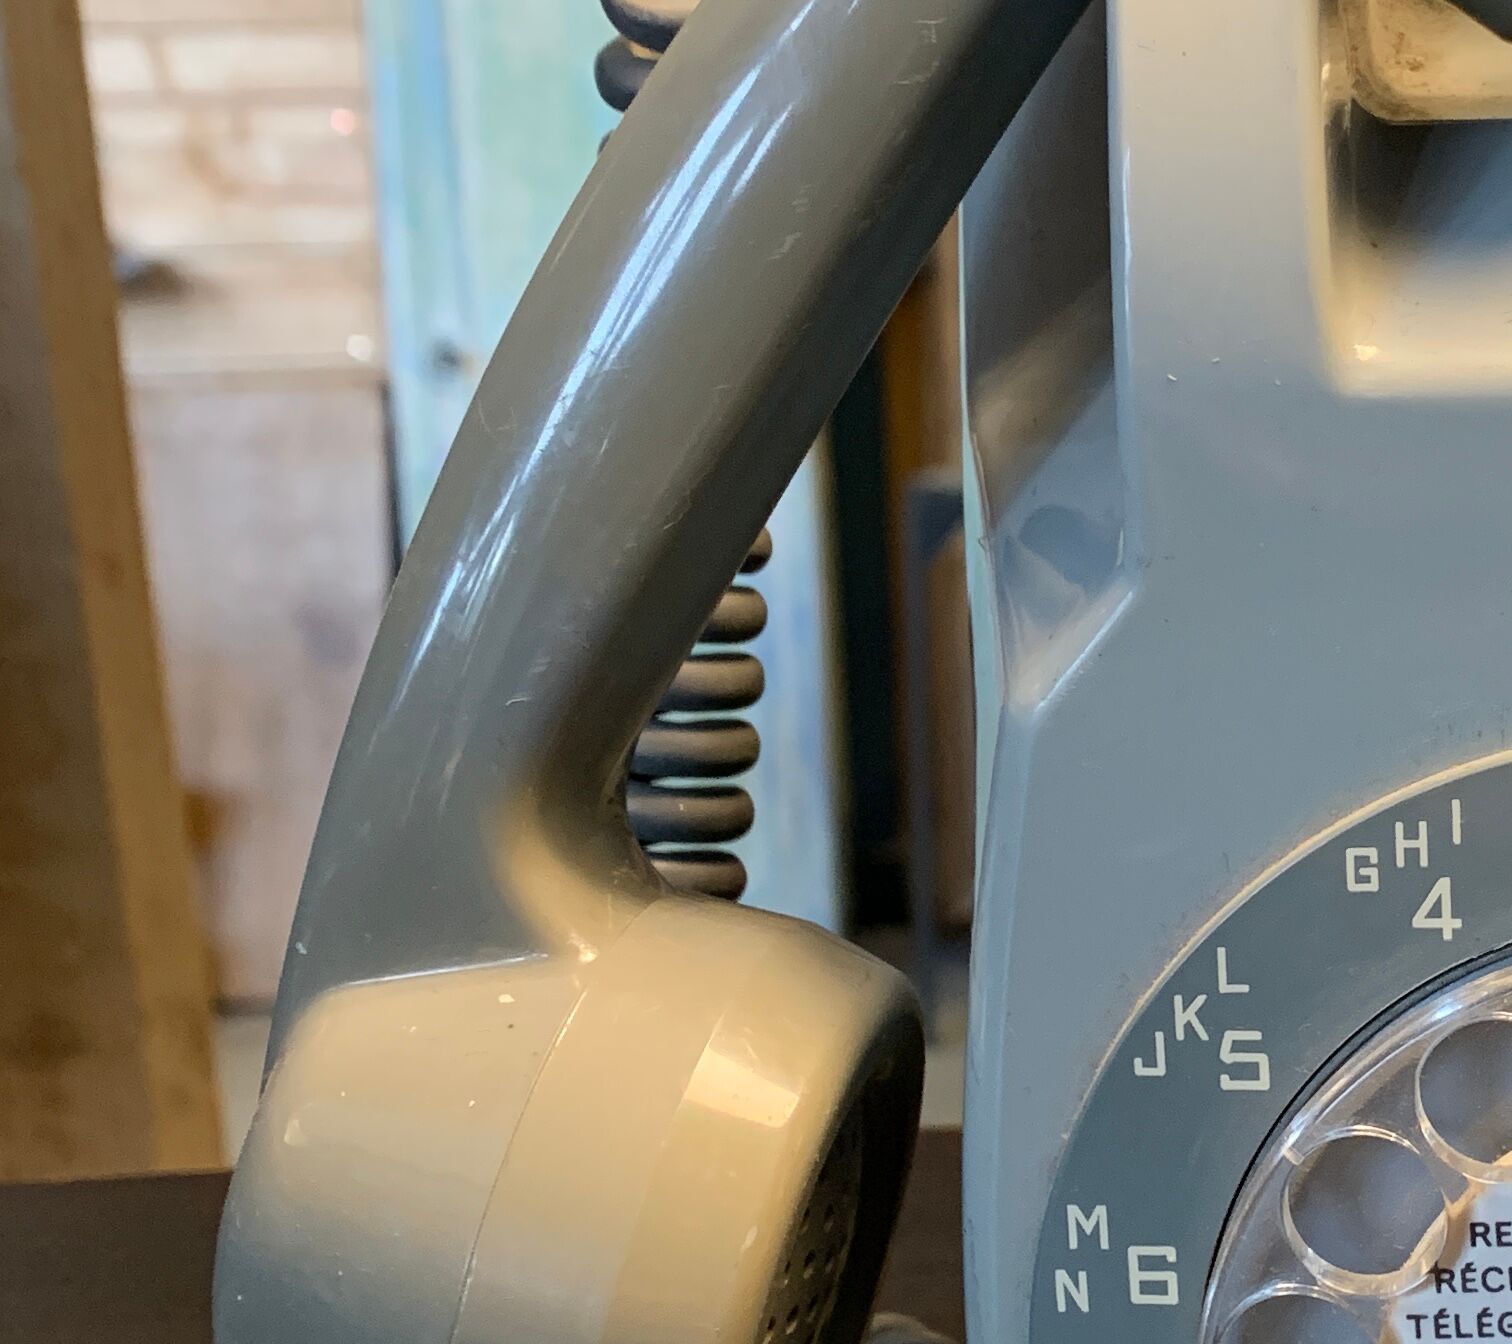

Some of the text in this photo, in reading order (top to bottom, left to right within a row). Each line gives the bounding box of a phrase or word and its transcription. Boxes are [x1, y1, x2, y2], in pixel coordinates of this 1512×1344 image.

[1412, 877, 1462, 941] 4
[1219, 1030, 1271, 1090] 5
[1127, 1246, 1179, 1305] 6
